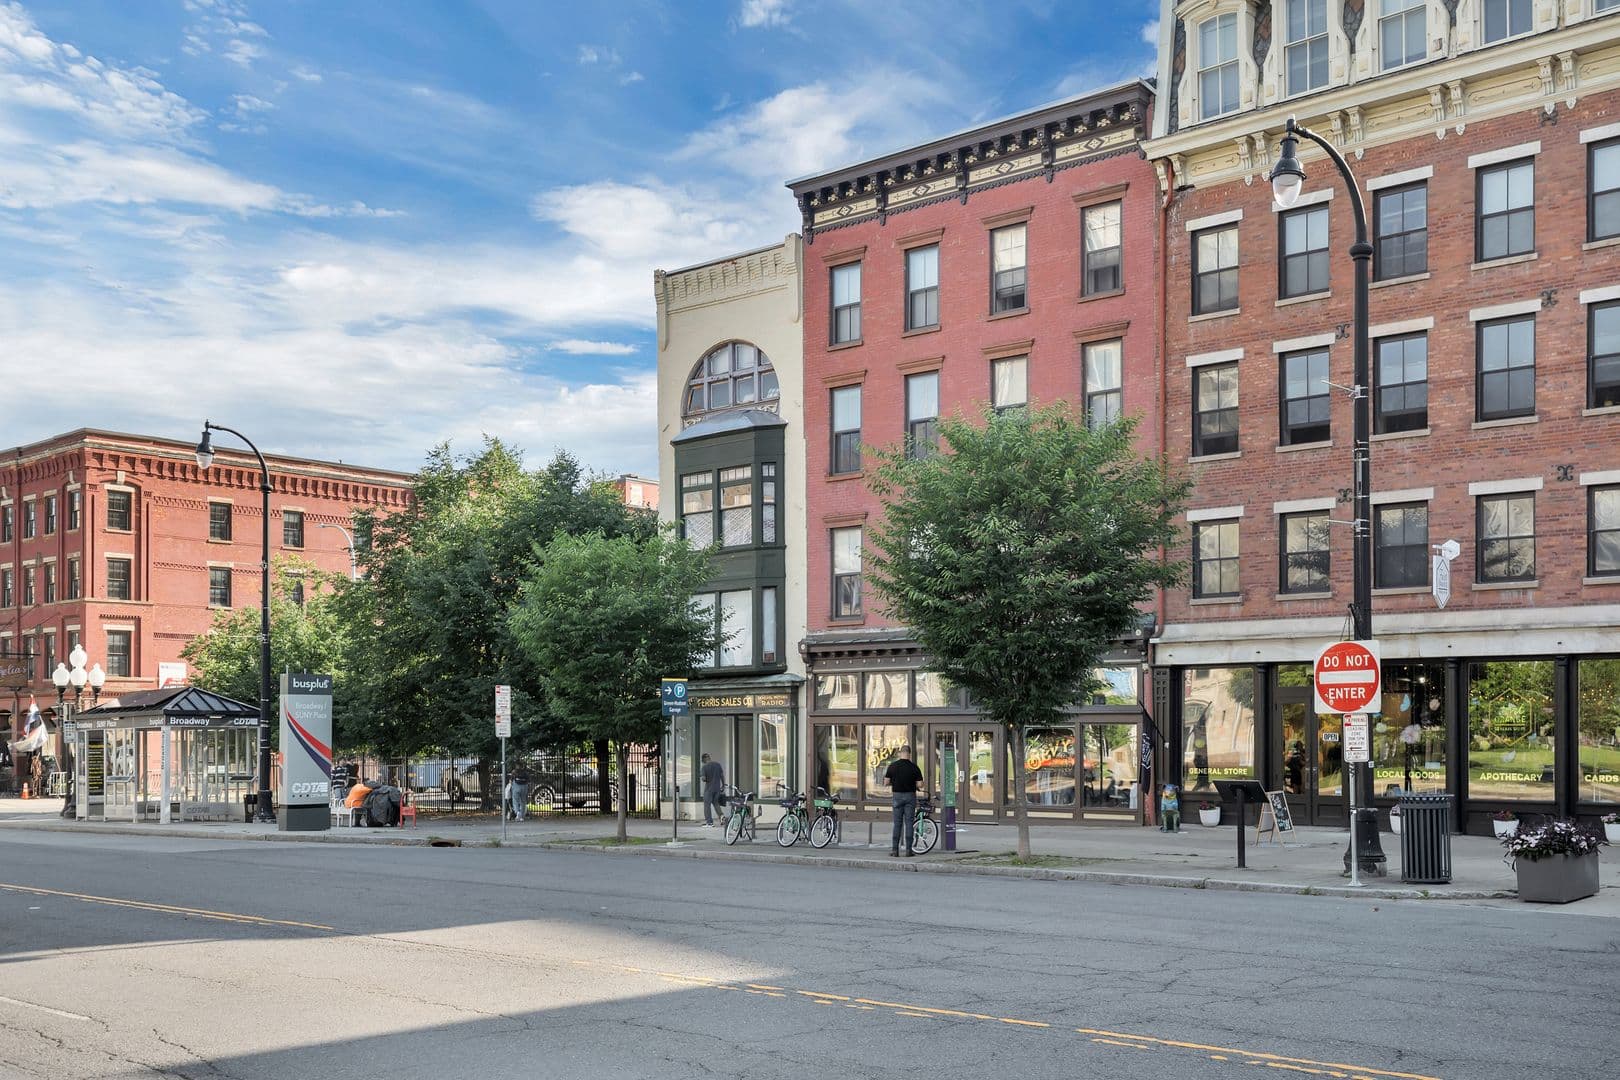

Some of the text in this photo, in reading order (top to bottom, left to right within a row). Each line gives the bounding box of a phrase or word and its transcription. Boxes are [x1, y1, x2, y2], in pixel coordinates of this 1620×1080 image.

[1323, 654, 1370, 668] DO NOT
[292, 677, 329, 691] busplus
[1328, 687, 1366, 699] ENTER
[721, 697, 742, 706] SALES
[170, 716, 210, 726] Broadway
[1188, 767, 1248, 775] GENERAL STORE
[1376, 770, 1440, 779] LOCAL GOODS
[1479, 772, 1619, 782] APOTHECARY CARDS
